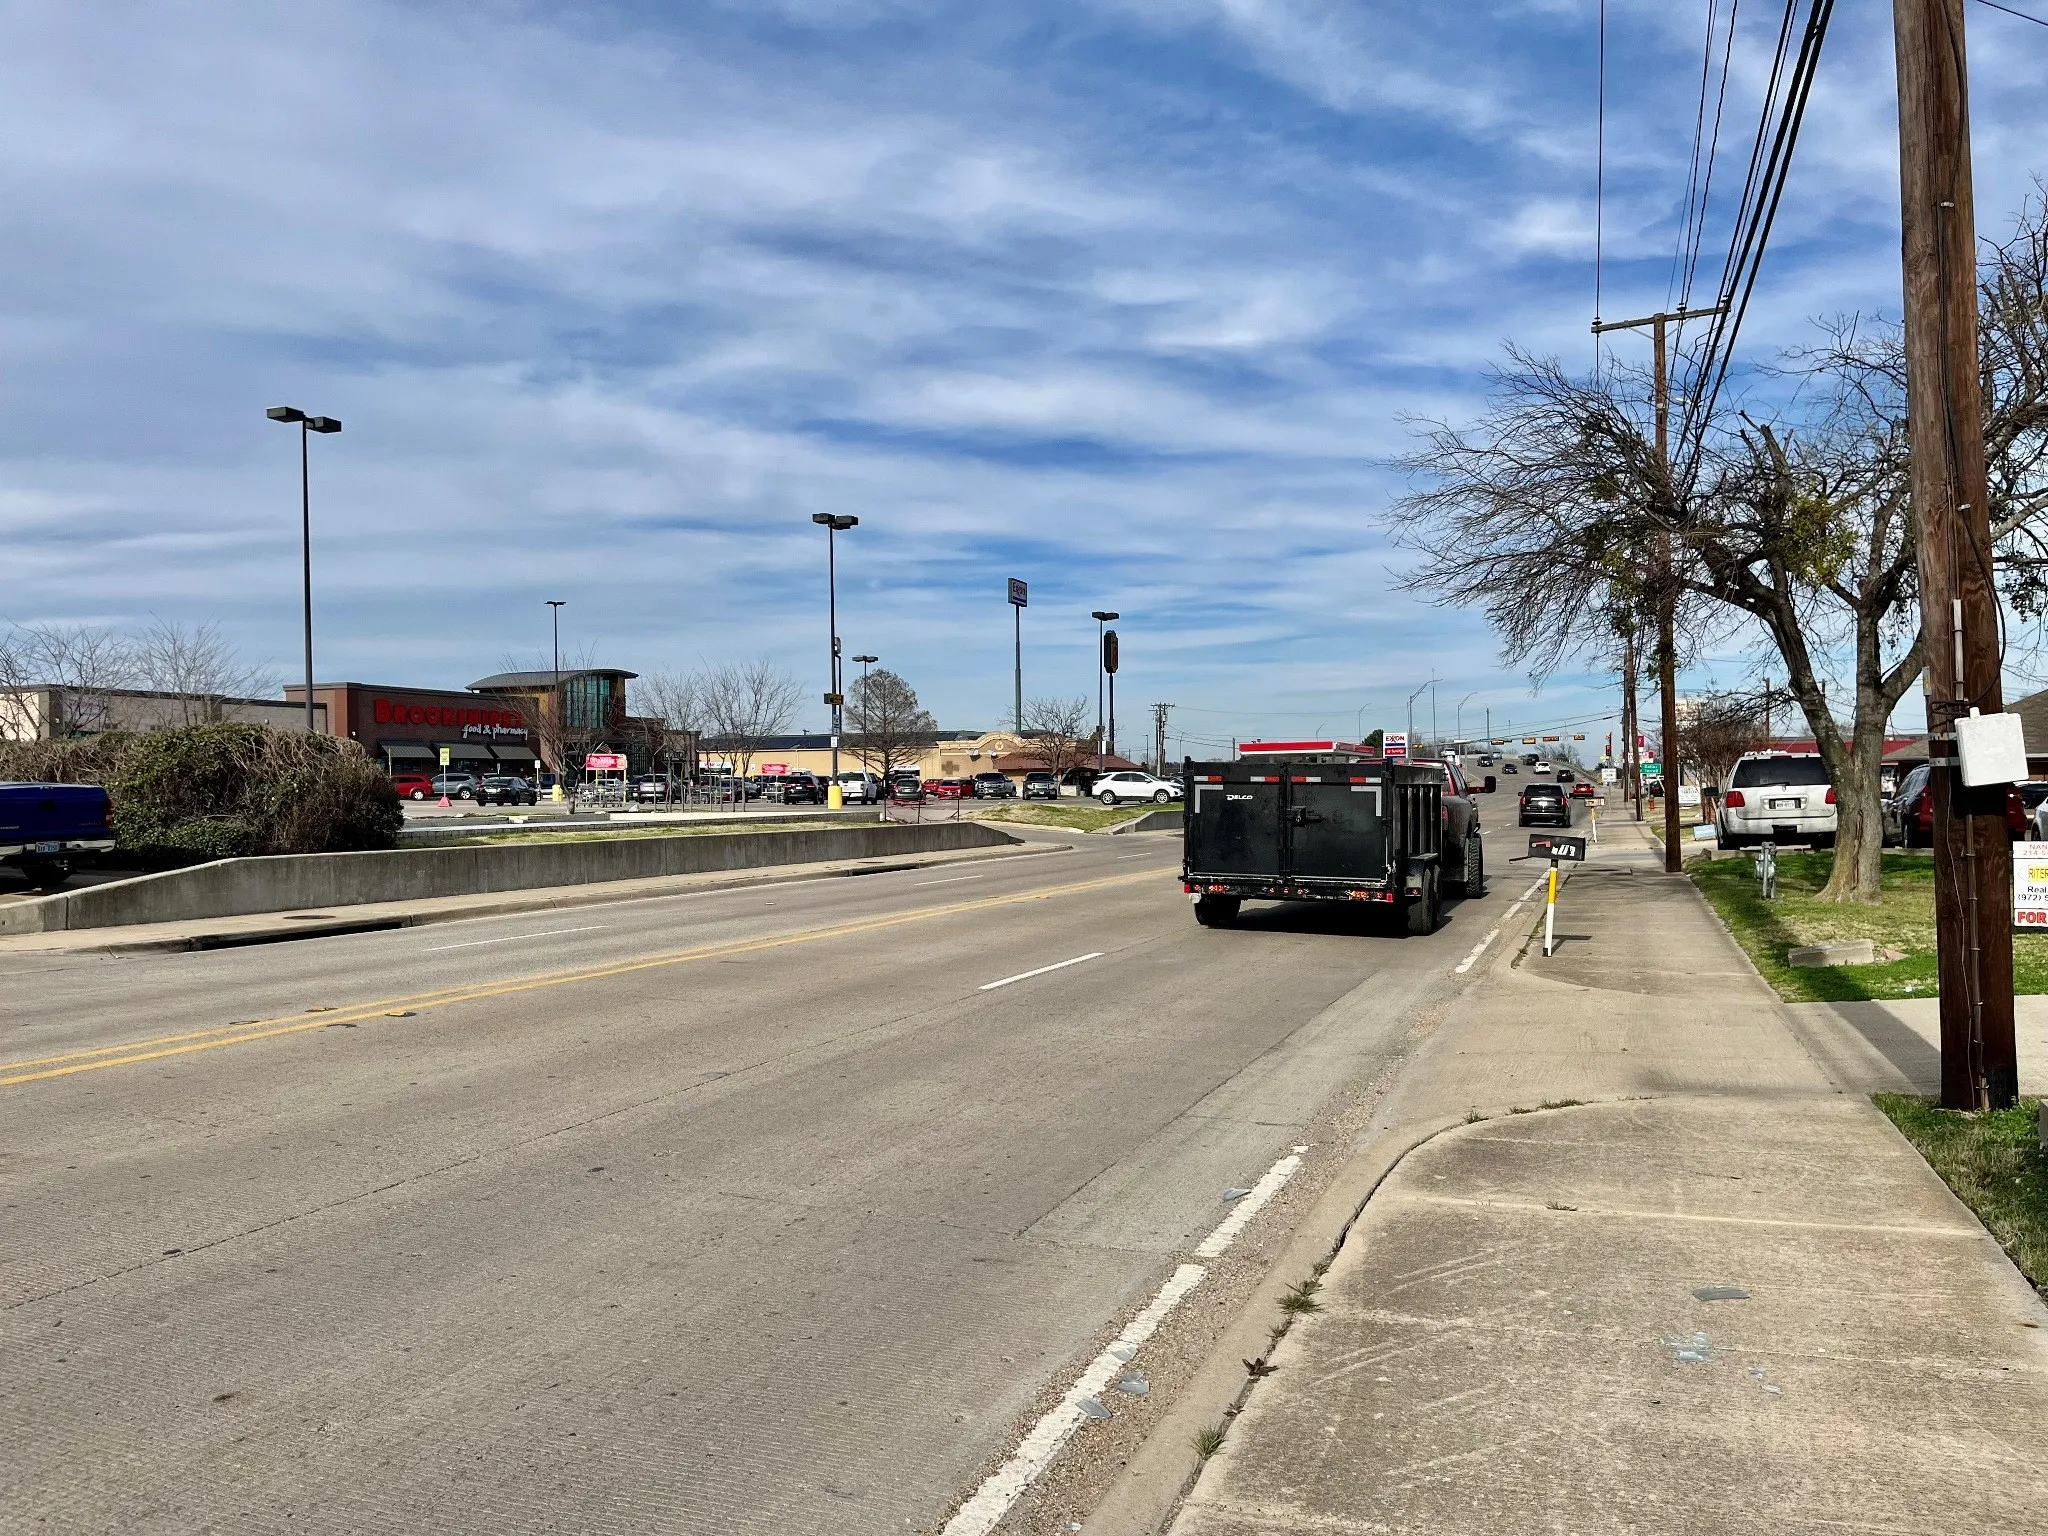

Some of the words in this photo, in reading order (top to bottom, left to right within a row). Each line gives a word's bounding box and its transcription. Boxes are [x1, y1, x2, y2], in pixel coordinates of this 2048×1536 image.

[461, 724, 481, 738] food
[482, 724, 491, 735] &
[492, 723, 528, 740] pharmacy
[1385, 735, 1405, 743] EXXON
[2017, 911, 2047, 924] FOR
